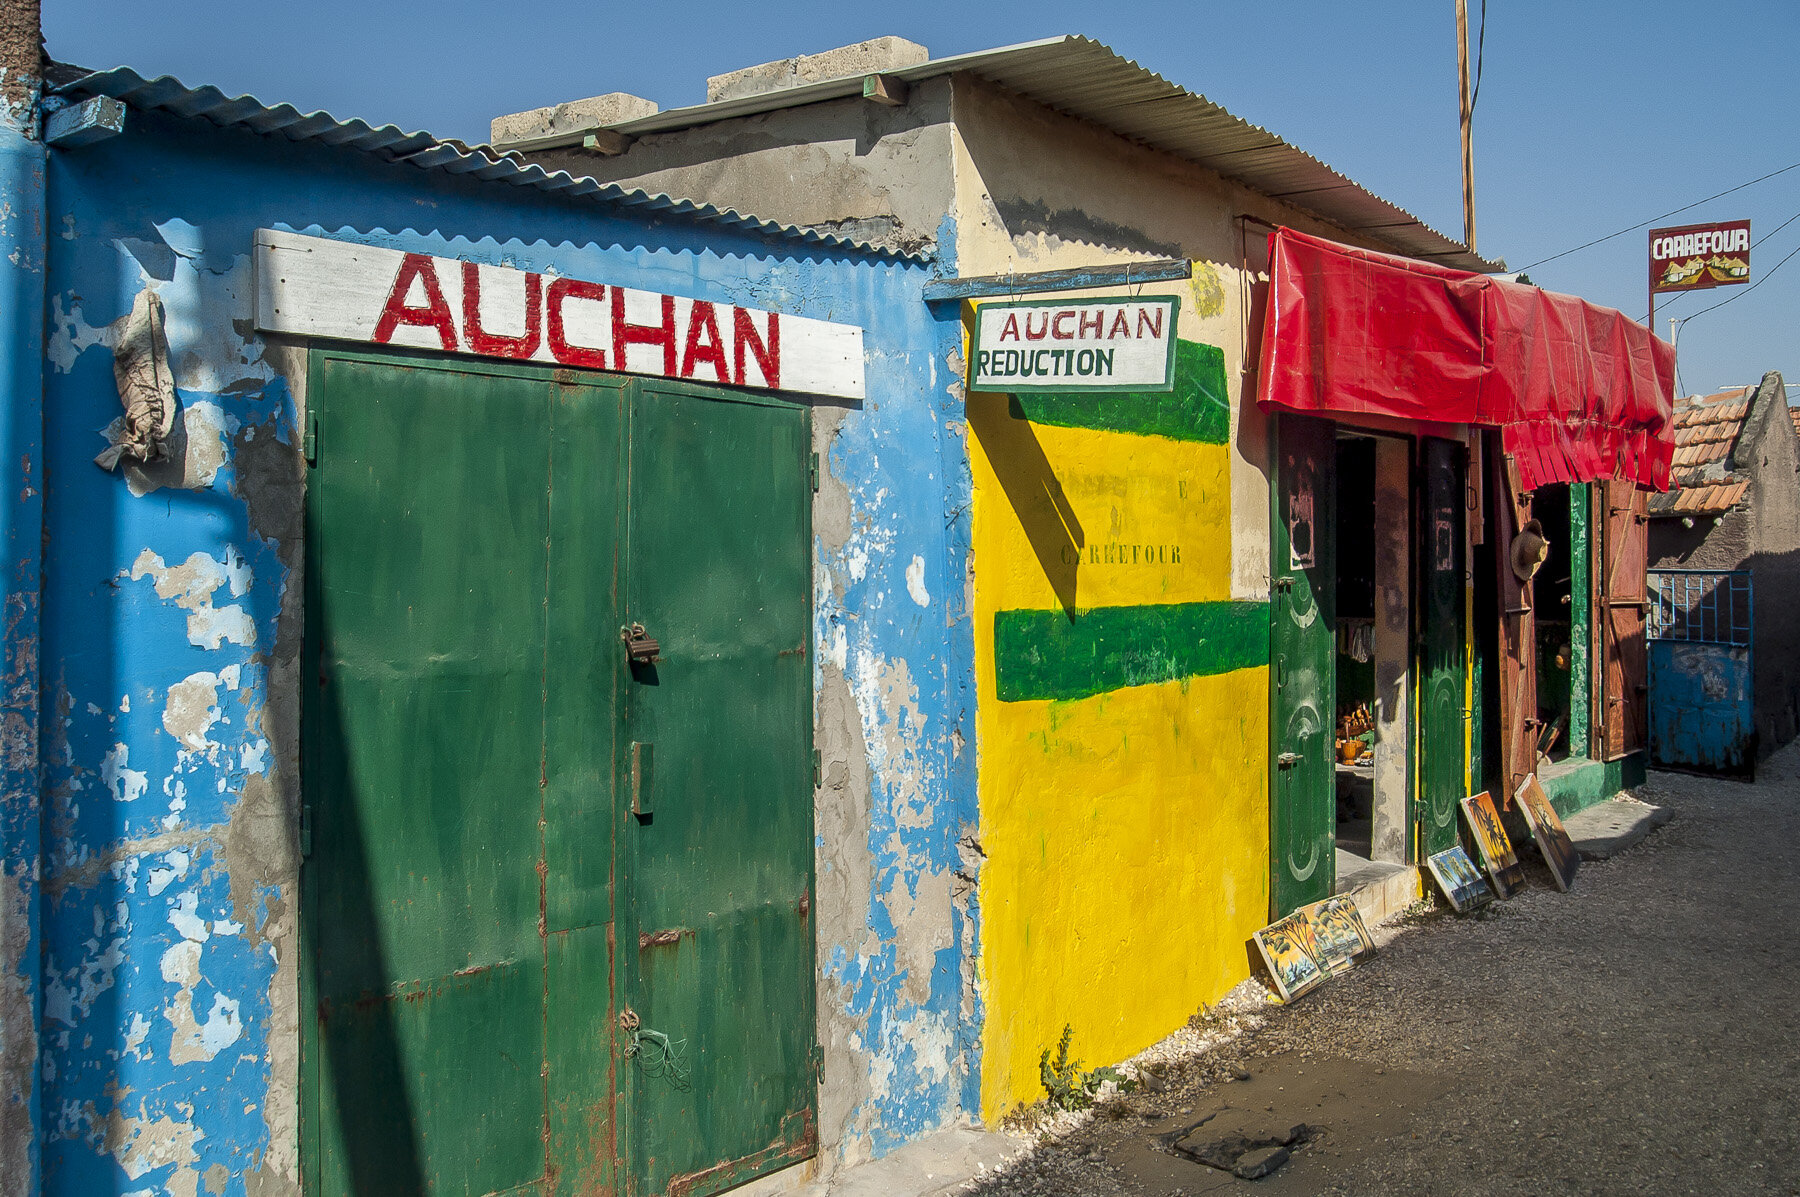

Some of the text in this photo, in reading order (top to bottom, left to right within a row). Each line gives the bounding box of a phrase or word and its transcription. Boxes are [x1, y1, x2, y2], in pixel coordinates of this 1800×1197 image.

[1653, 229, 1749, 260] CARREFOUR
[371, 251, 781, 390] AUCHAN
[999, 307, 1163, 342] AUCHAN
[977, 348, 1115, 378] REDUCTION
